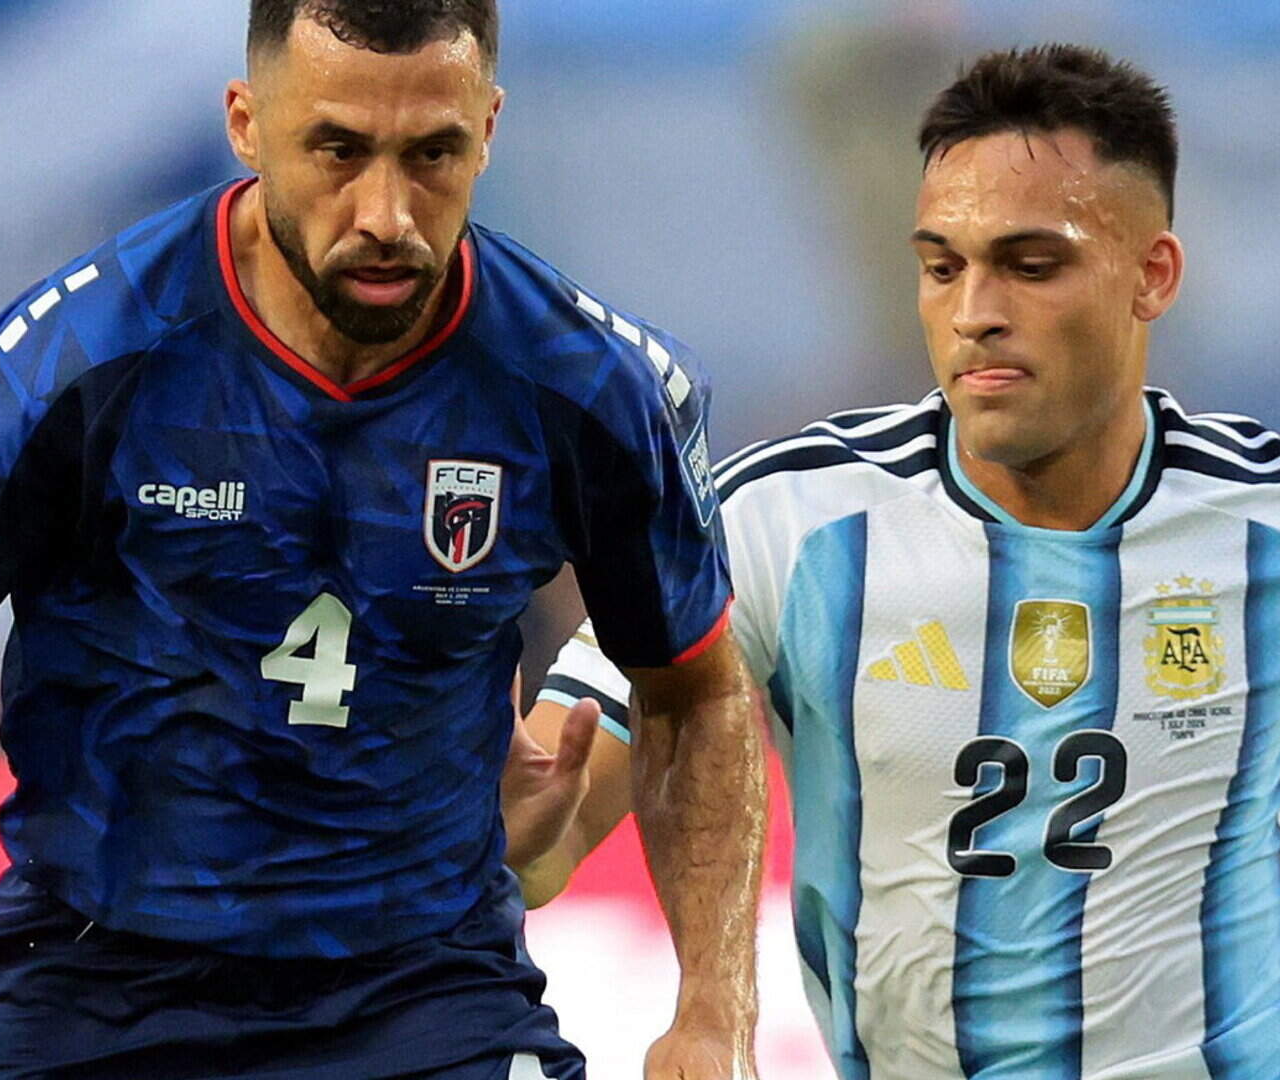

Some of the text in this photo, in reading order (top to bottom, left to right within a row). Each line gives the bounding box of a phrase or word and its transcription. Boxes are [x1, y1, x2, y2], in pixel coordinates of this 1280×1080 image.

[435, 467, 496, 485] FCF
[138, 481, 246, 514] capelli
[185, 508, 242, 521] SPORT
[260, 592, 357, 728] 4
[1032, 667, 1068, 681] FIFA
[946, 728, 1128, 879] 22
